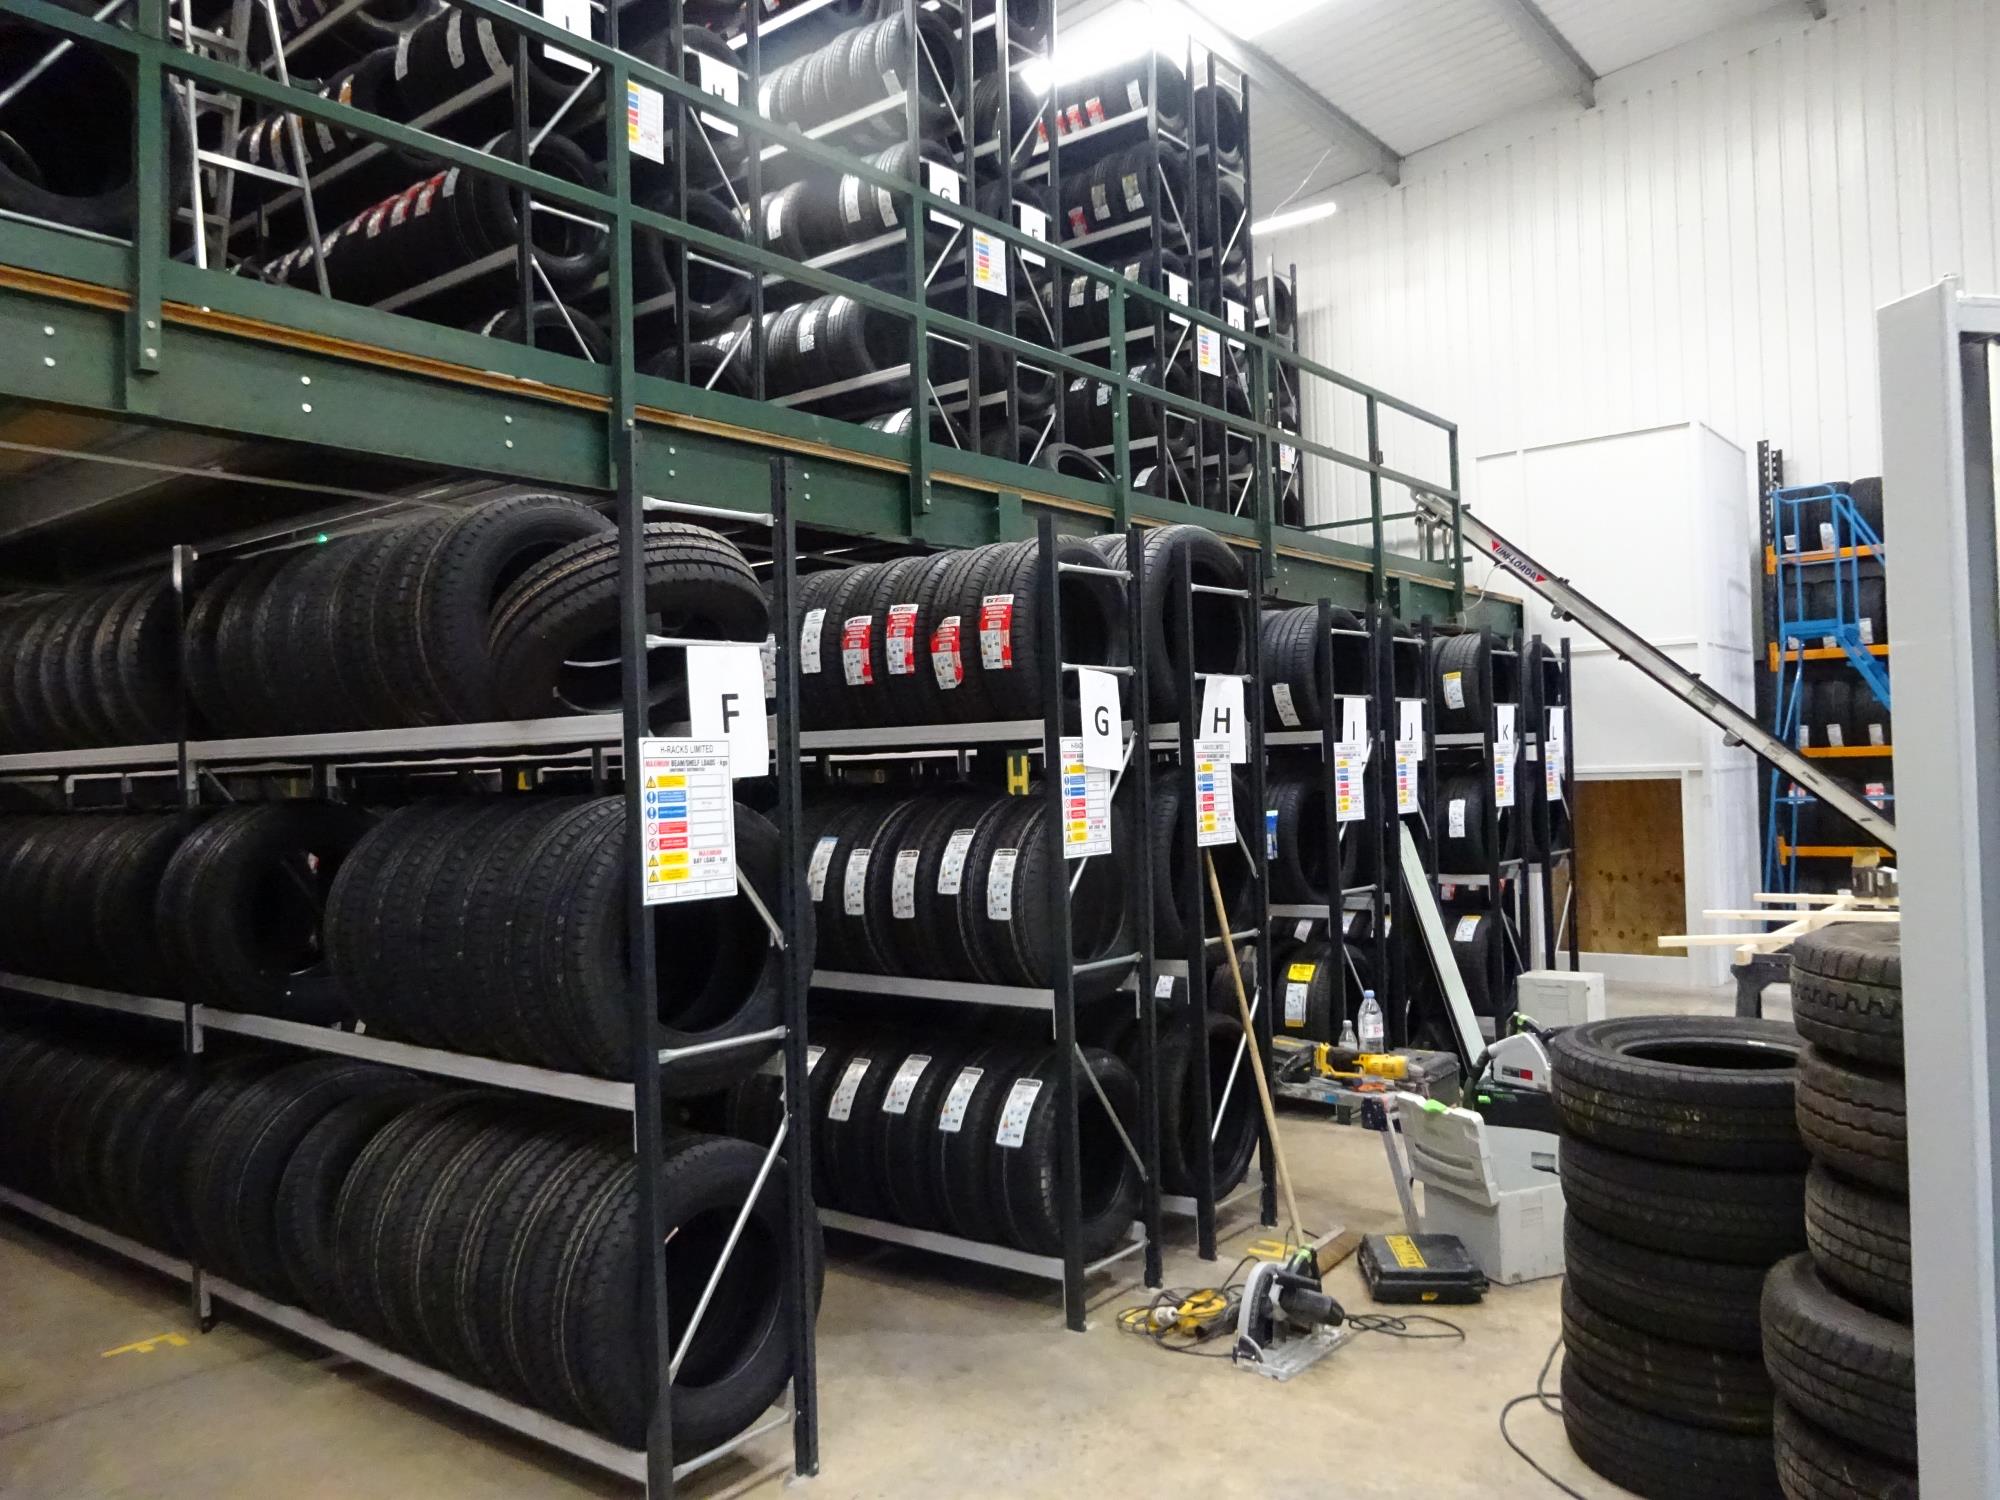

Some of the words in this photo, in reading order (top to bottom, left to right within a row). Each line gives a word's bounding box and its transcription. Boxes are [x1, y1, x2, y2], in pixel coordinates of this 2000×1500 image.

[721, 693, 740, 734] F
[1094, 705, 1110, 736] G
[1212, 707, 1231, 734] H
[1408, 722, 1413, 741] J
[1502, 724, 1509, 741] K
[1552, 725, 1557, 740] L
[660, 745, 688, 754] H-RACKS
[690, 744, 714, 753] LIMITED
